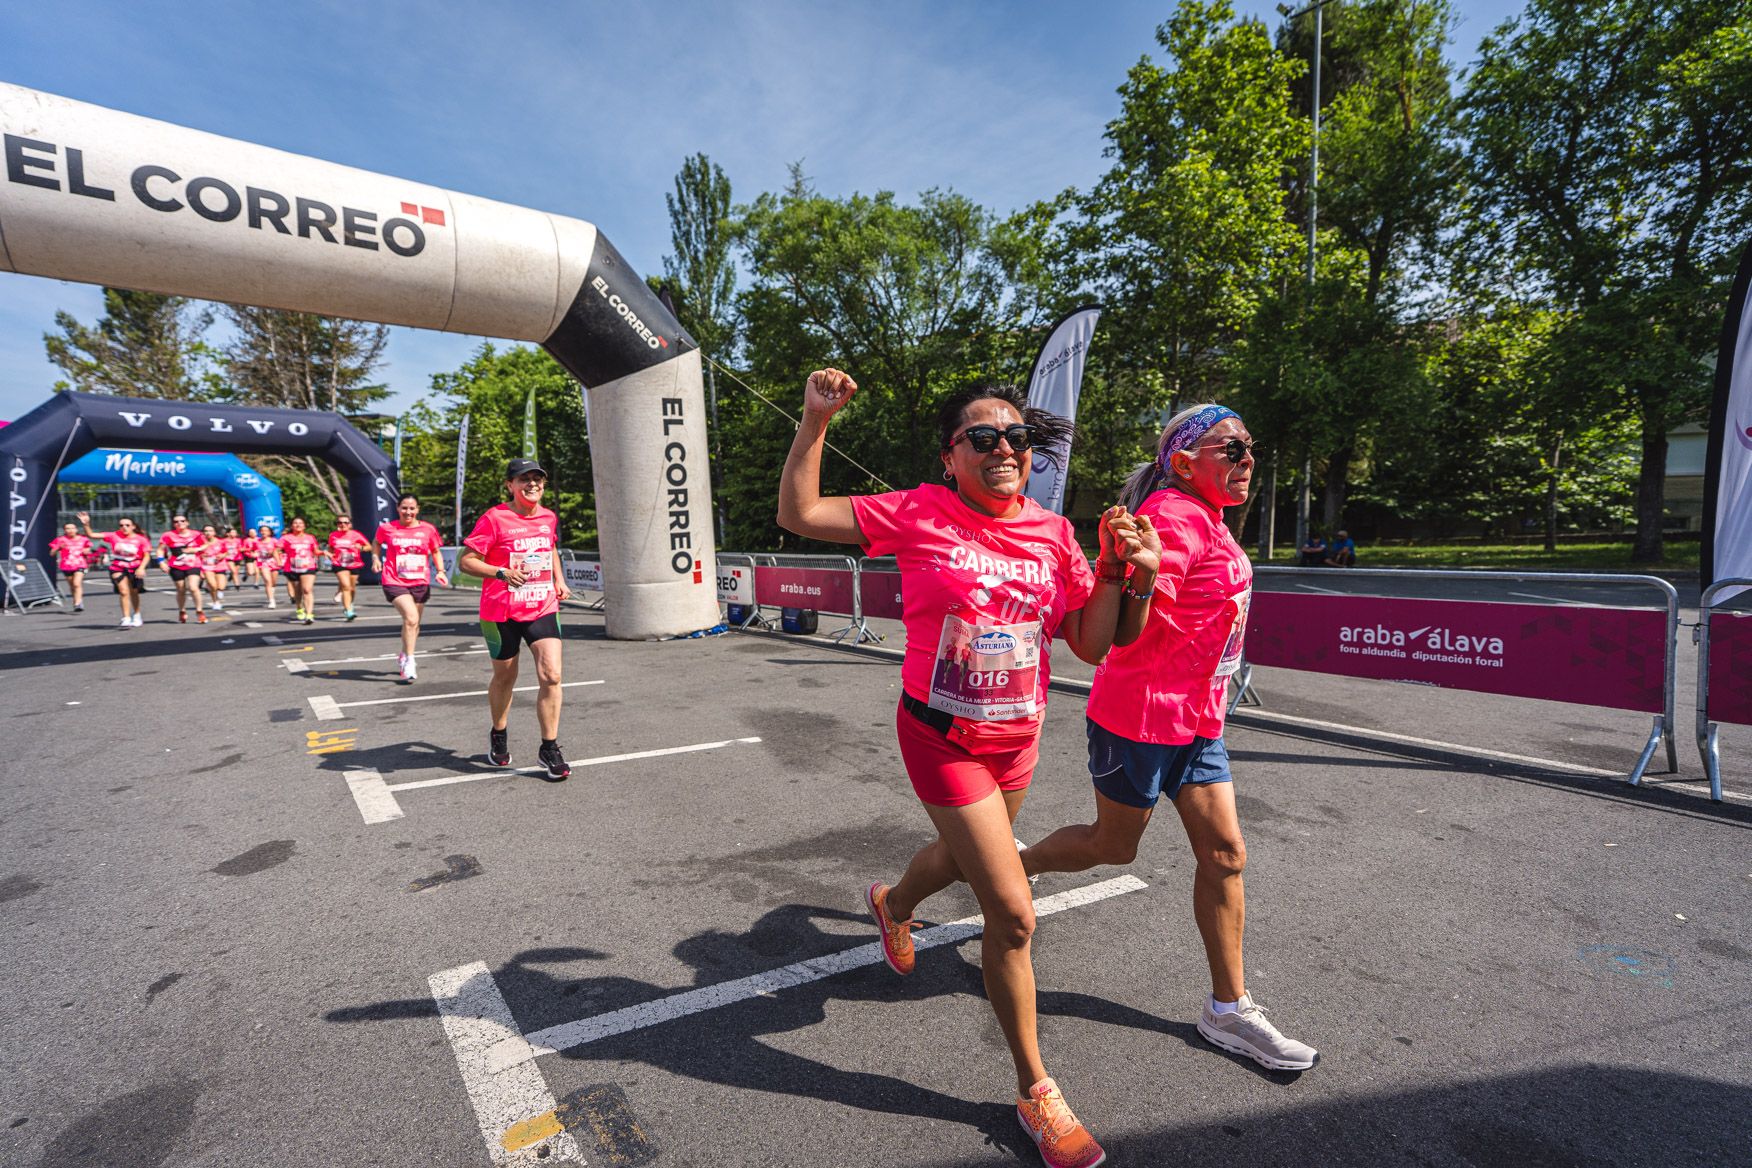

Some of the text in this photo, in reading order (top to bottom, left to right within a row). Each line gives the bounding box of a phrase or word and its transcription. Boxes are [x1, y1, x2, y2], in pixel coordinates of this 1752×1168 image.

[3, 133, 426, 258] EL CORREO
[591, 275, 660, 350] EL CORREO
[118, 411, 309, 436] VOLVO
[661, 397, 693, 575] EL CORREO
[9, 467, 27, 588] VOLVO
[950, 546, 1051, 586] CARRERA
[780, 583, 821, 596] araba.eus
[1339, 624, 1503, 654] araba álava
[1339, 644, 1503, 668] foru aldundia diputación foral
[968, 671, 1009, 687] 016
[934, 687, 957, 699] CARRERA
[941, 701, 975, 716] OYSHO
[996, 708, 1026, 717] Santander
